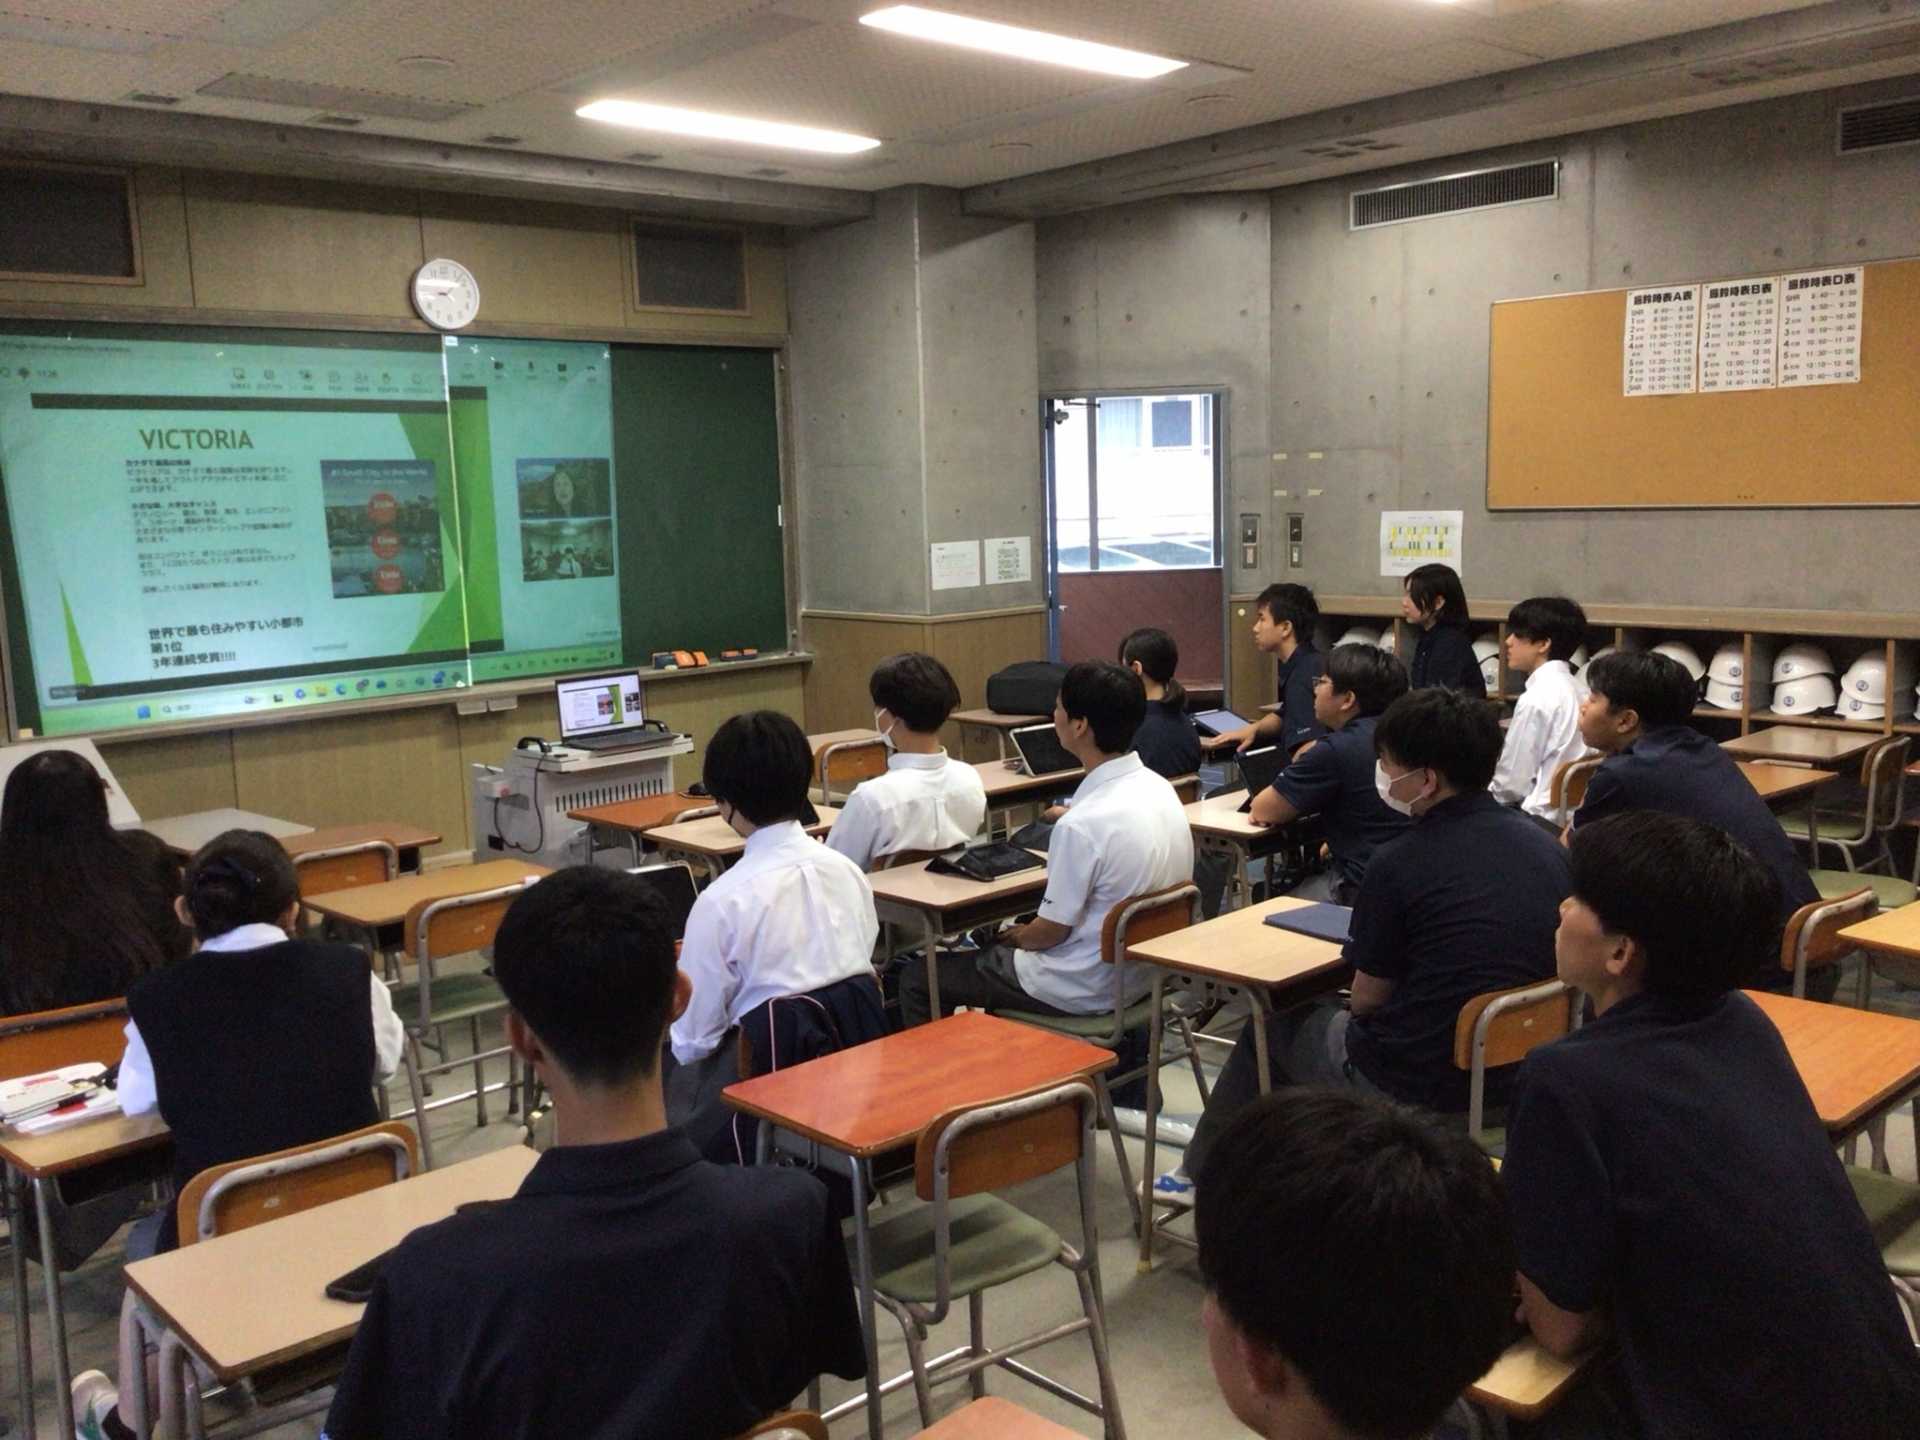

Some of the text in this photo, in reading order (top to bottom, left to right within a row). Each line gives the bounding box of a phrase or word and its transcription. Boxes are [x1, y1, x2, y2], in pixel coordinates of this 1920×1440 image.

[139, 428, 254, 450] VICTORIA
[149, 617, 303, 640] 世界で最も住みやすい小都市
[151, 641, 182, 654] 第1位
